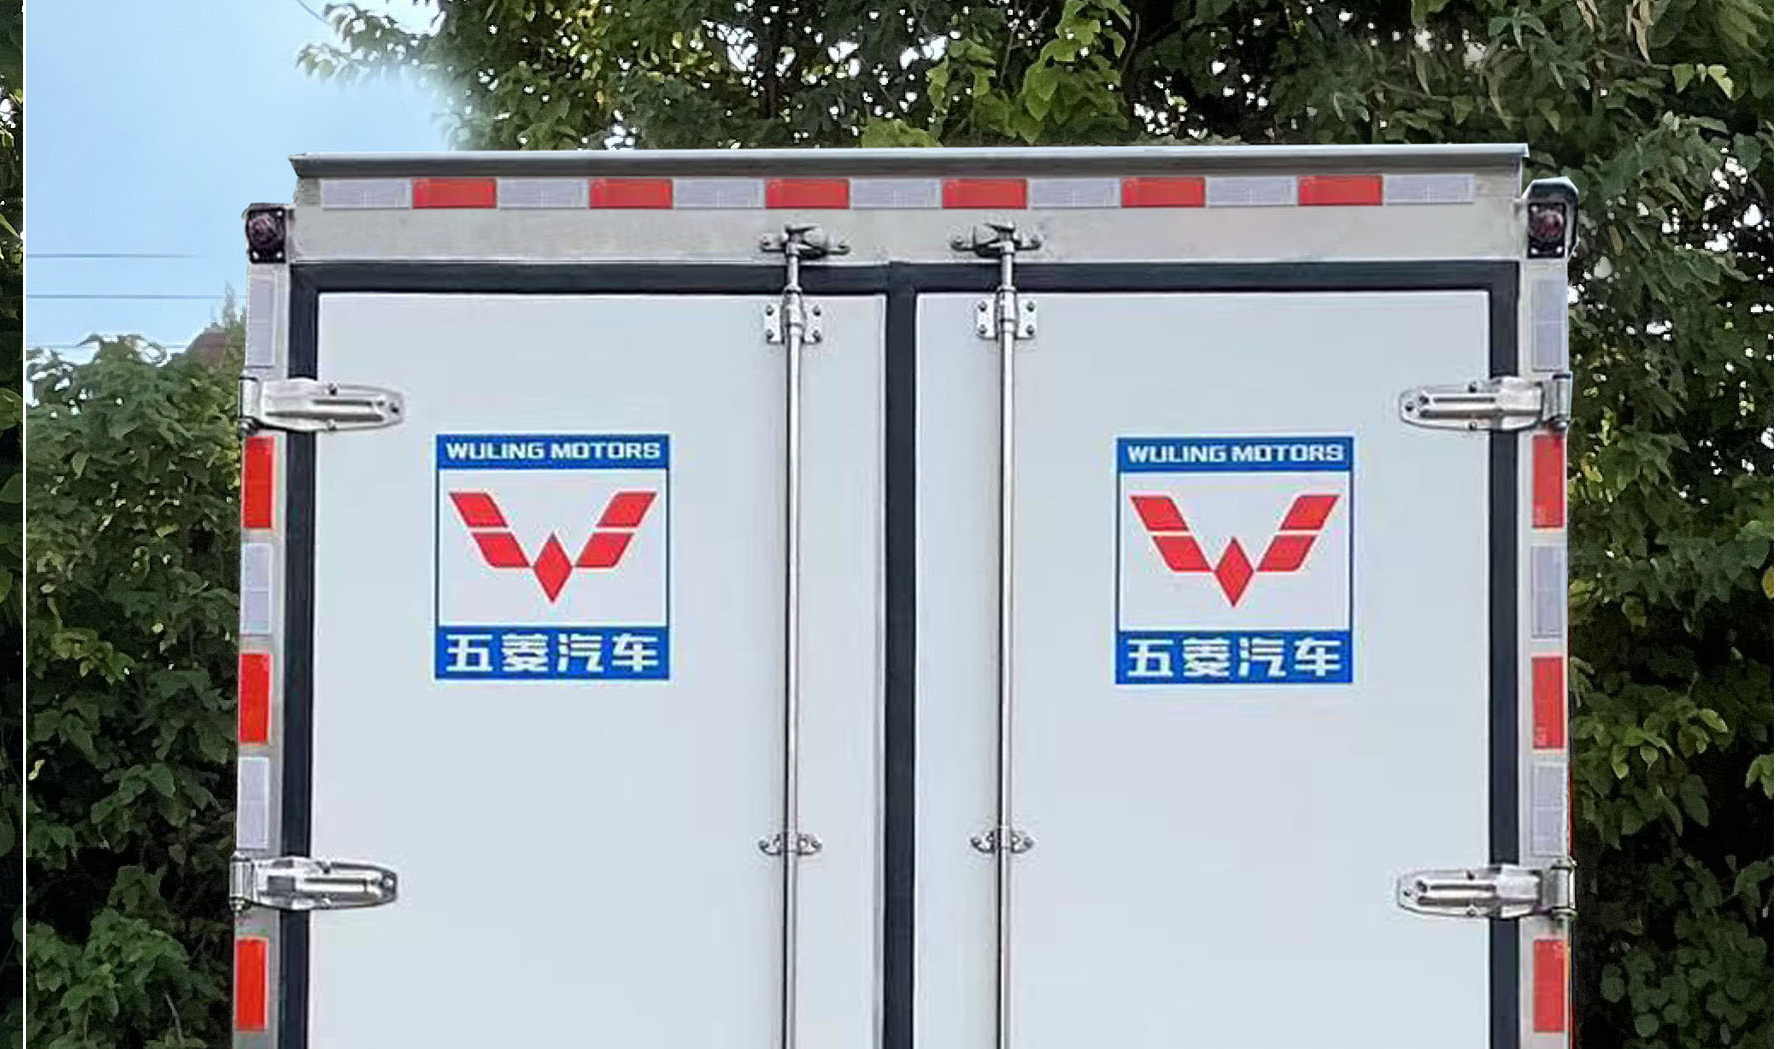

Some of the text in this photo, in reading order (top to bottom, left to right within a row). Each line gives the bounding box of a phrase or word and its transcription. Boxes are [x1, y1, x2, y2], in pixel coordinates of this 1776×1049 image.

[446, 442, 661, 460] WULING MOTORS
[1127, 444, 1344, 463] WULING MOTORS
[446, 633, 659, 672] 五菱汽车
[1127, 637, 1341, 677] 五菱汽车
